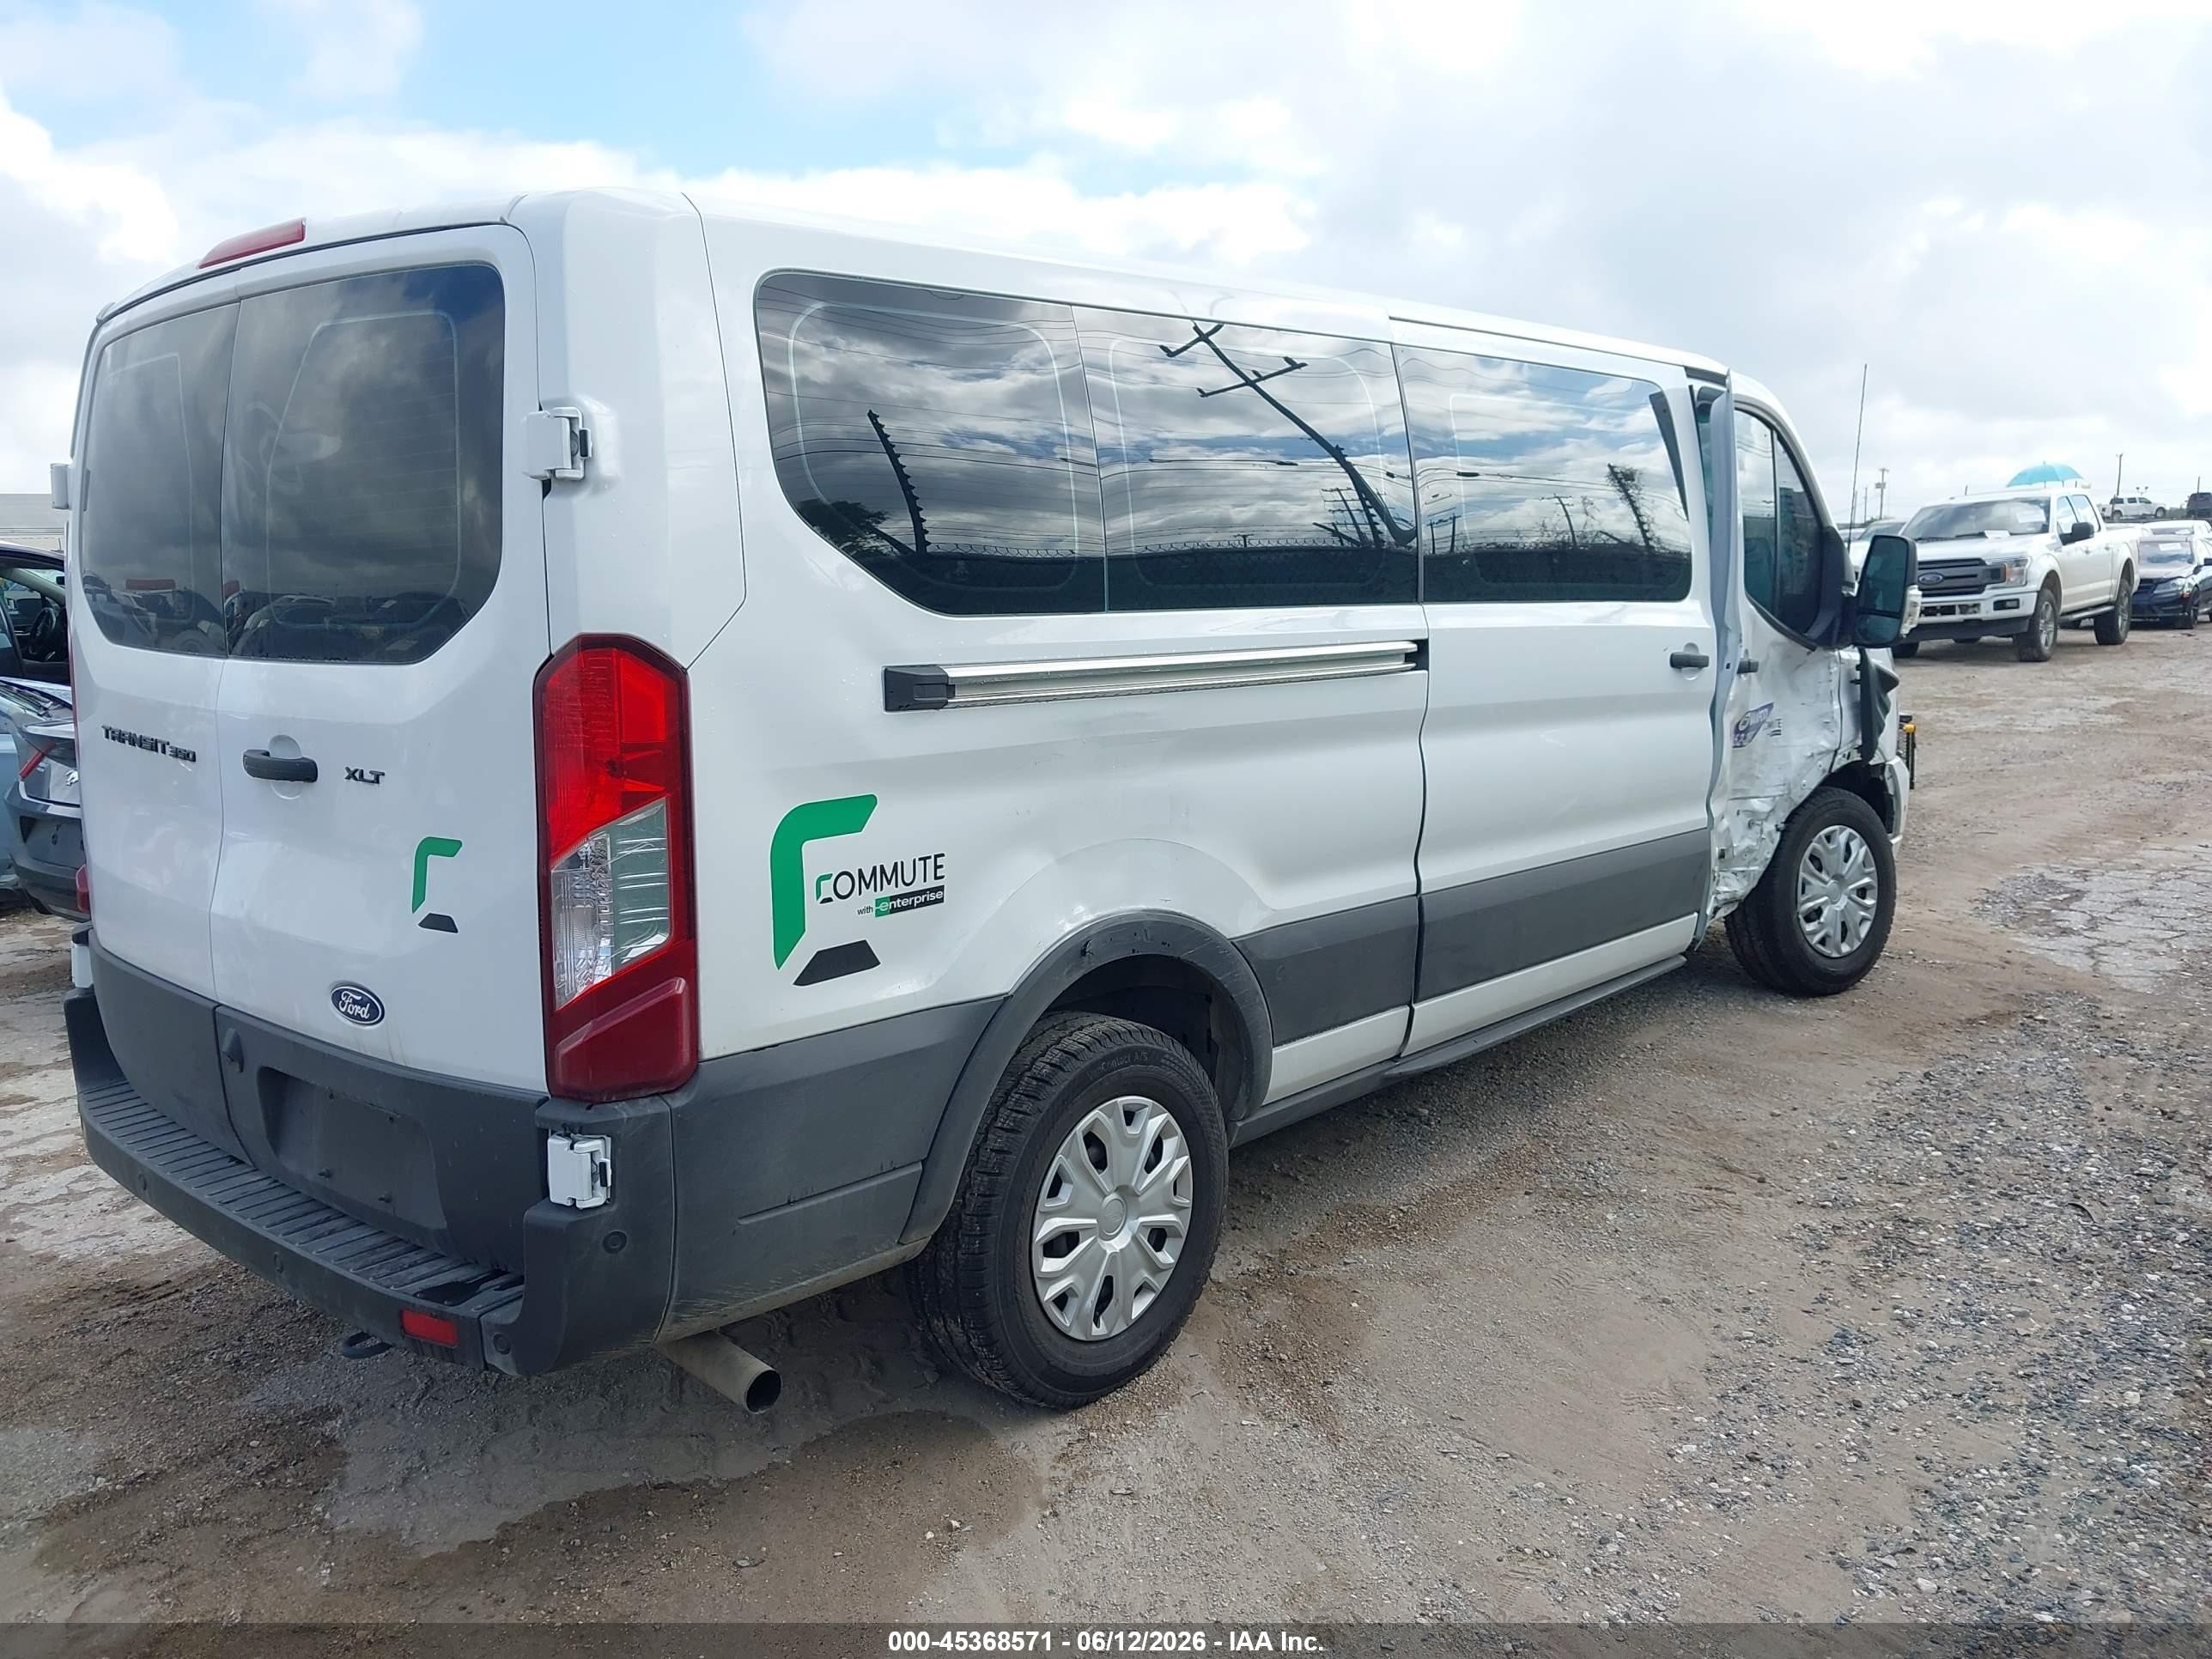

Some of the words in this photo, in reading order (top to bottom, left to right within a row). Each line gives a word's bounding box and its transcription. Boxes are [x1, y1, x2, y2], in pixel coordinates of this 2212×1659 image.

[101, 725, 170, 756] TRANSIT
[168, 744, 196, 763] 350
[344, 766, 386, 784] XLT
[816, 853, 945, 904] COMMUTE
[857, 903, 873, 915] with
[877, 890, 944, 912] enterprise
[338, 990, 370, 1019] Ford
